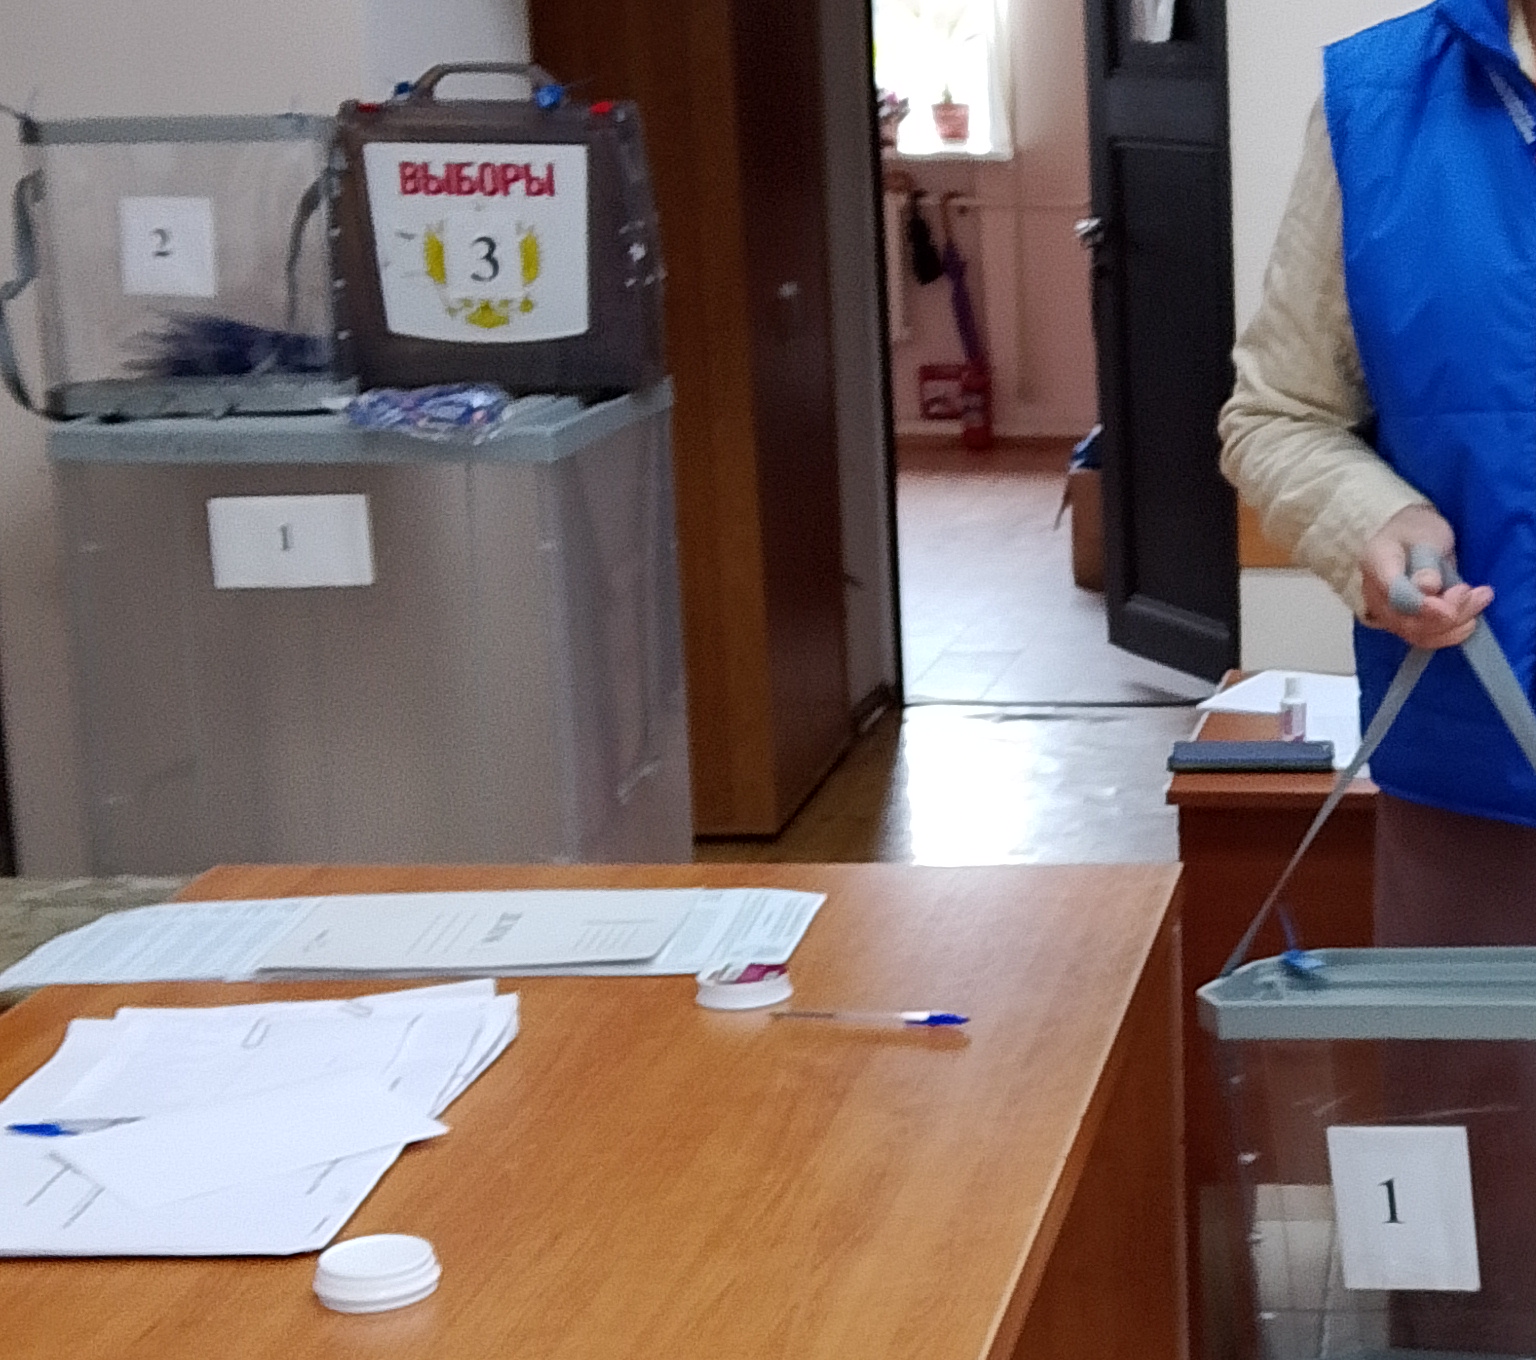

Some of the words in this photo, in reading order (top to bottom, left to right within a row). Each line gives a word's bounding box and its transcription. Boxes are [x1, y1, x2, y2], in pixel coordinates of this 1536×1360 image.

[399, 161, 555, 197] ВЫБОРЫ
[150, 227, 173, 258] 2
[470, 235, 500, 283] 3
[278, 525, 292, 553] 1
[1379, 1178, 1404, 1224] 1
